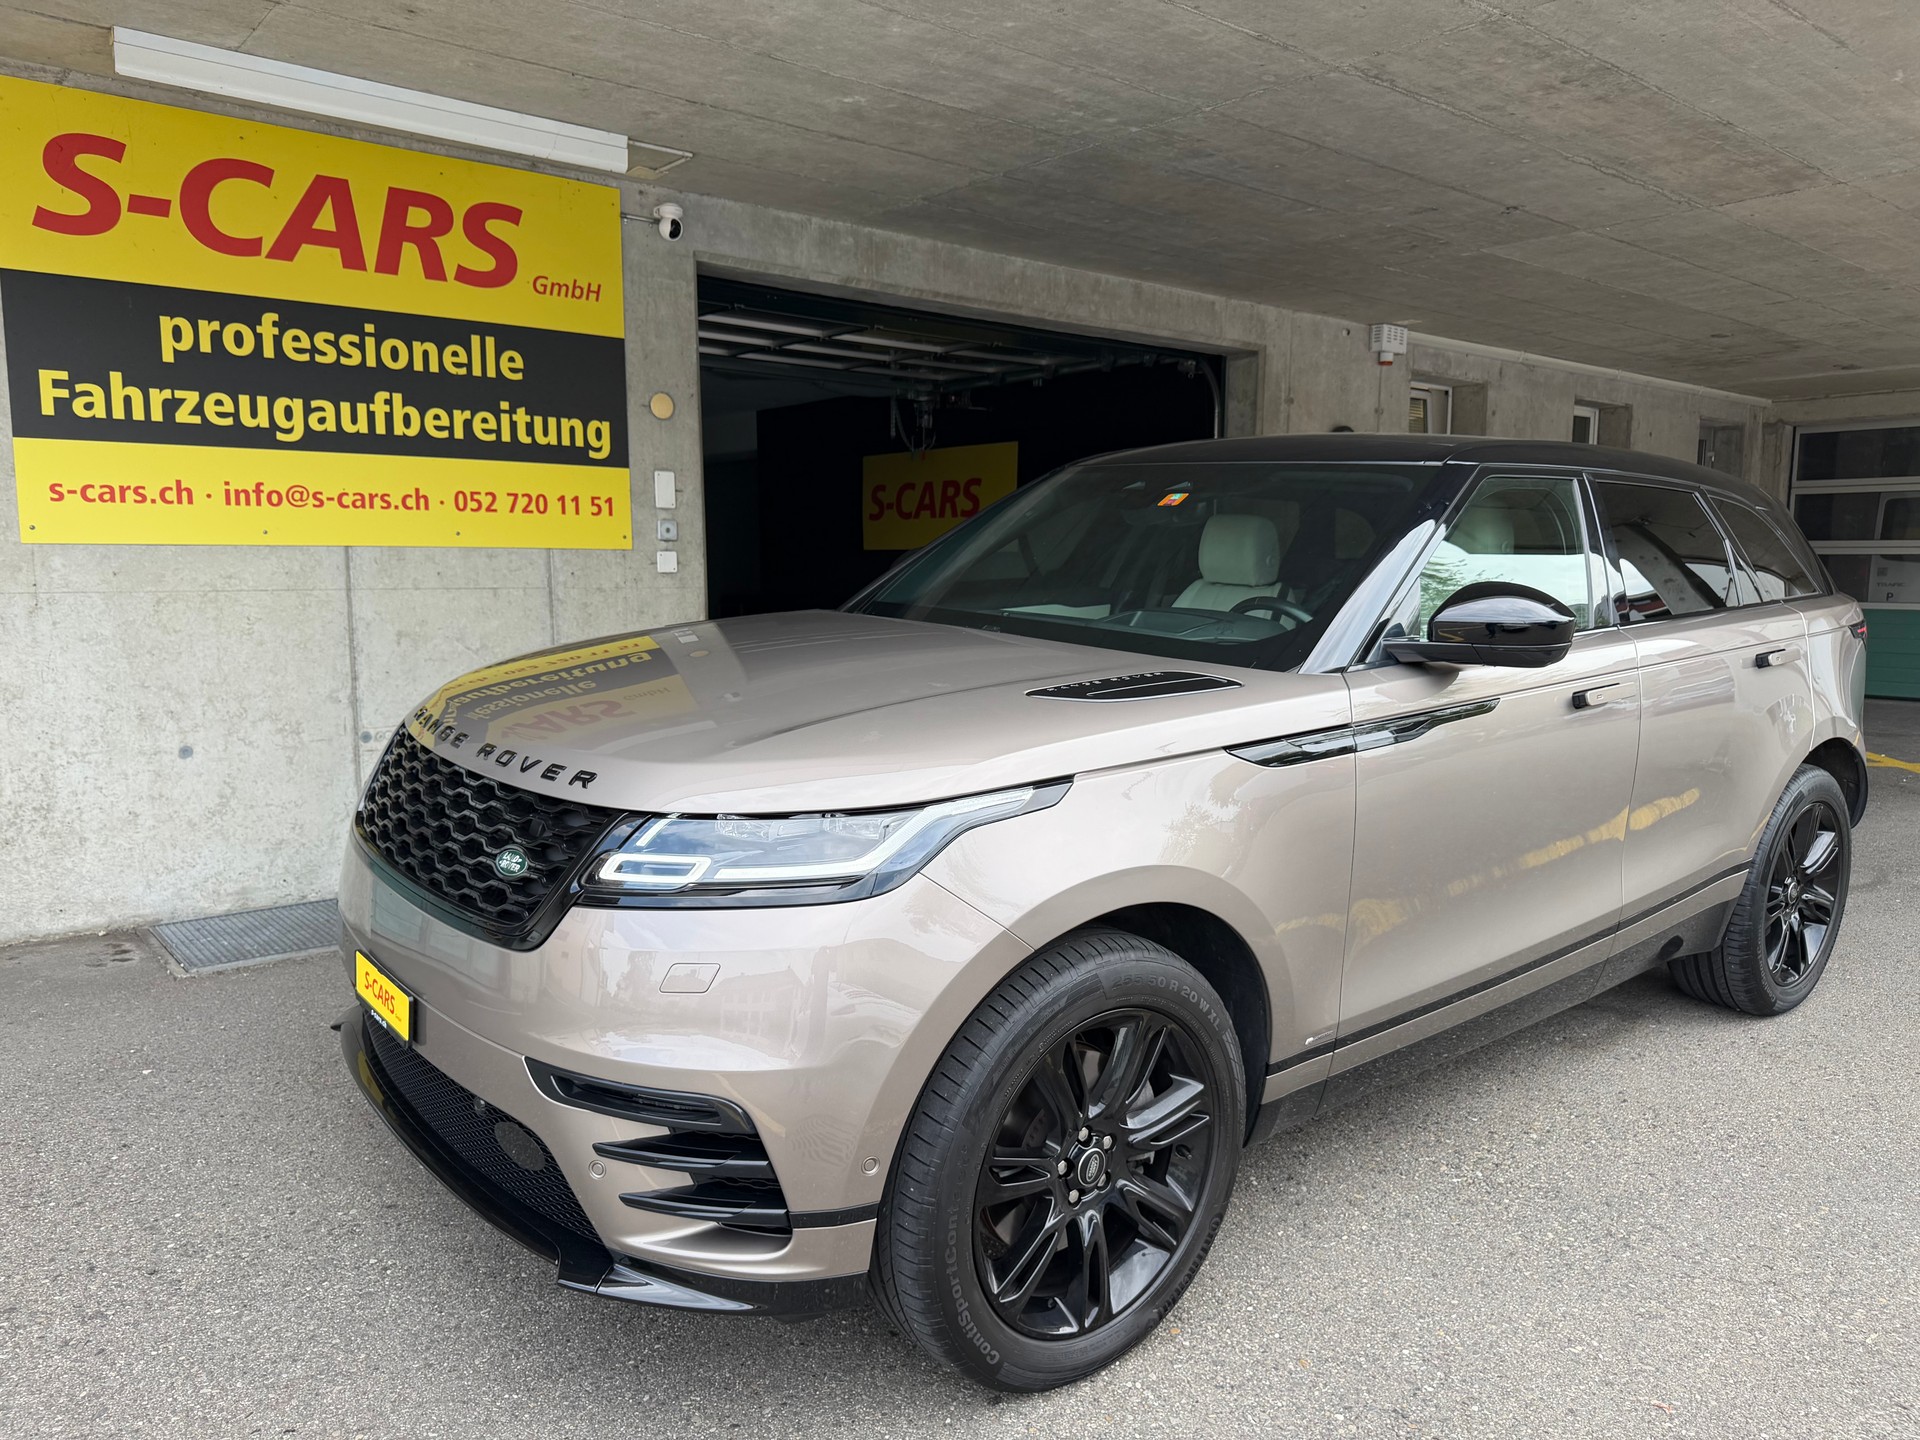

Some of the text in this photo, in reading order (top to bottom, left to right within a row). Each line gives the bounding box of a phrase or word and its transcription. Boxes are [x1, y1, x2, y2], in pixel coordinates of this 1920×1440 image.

[32, 132, 602, 303] S-CARS GmbH
[159, 313, 525, 381] professionelle
[38, 368, 611, 460] Fahrzeugaufbereitung
[49, 479, 615, 519] s-cars.ch info@s-cars.ch 052 720 11 51
[869, 478, 983, 522] S-CARS
[413, 706, 598, 789] RANGE ROVER
[364, 970, 396, 1015] S-CARS
[1180, 985, 1199, 1003] 20
